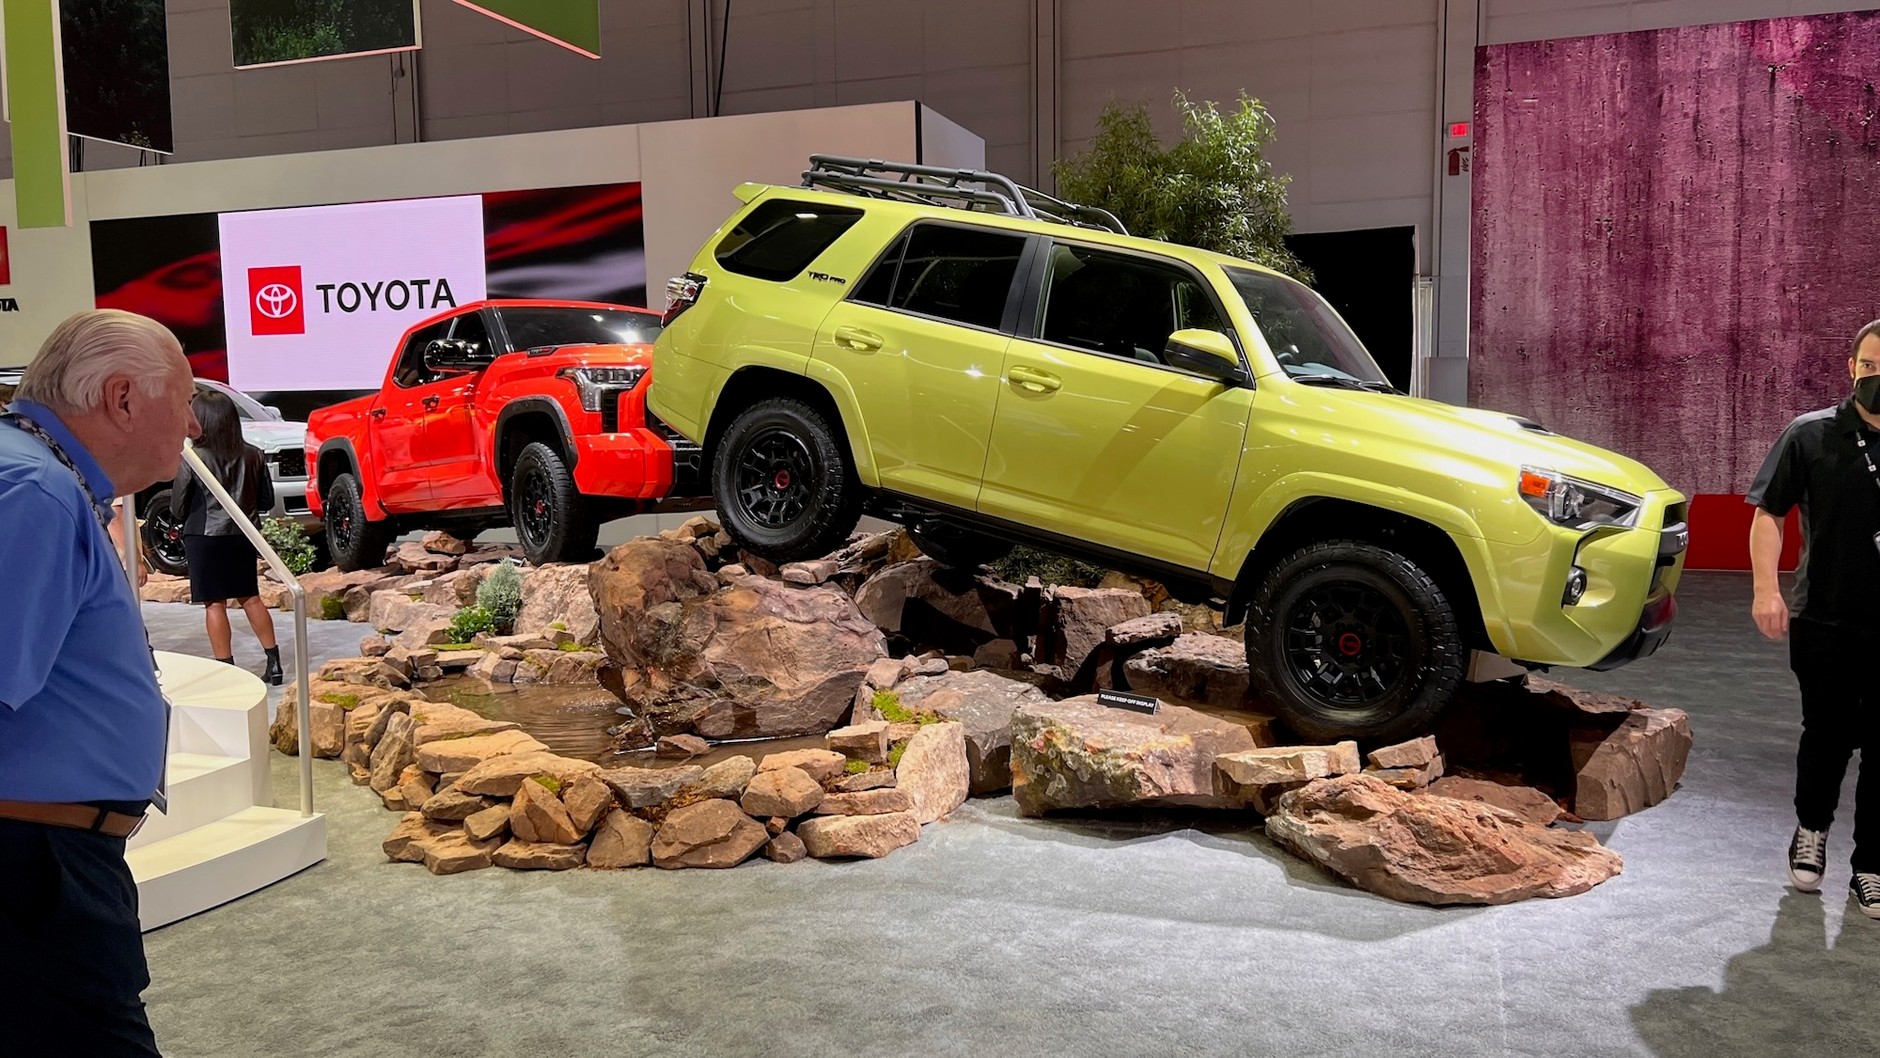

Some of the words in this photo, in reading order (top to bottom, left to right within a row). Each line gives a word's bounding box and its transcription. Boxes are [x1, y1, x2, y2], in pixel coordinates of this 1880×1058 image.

[808, 271, 829, 281] TRD
[316, 278, 456, 313] TOYOTA
[1100, 694, 1116, 702] PLEASE
